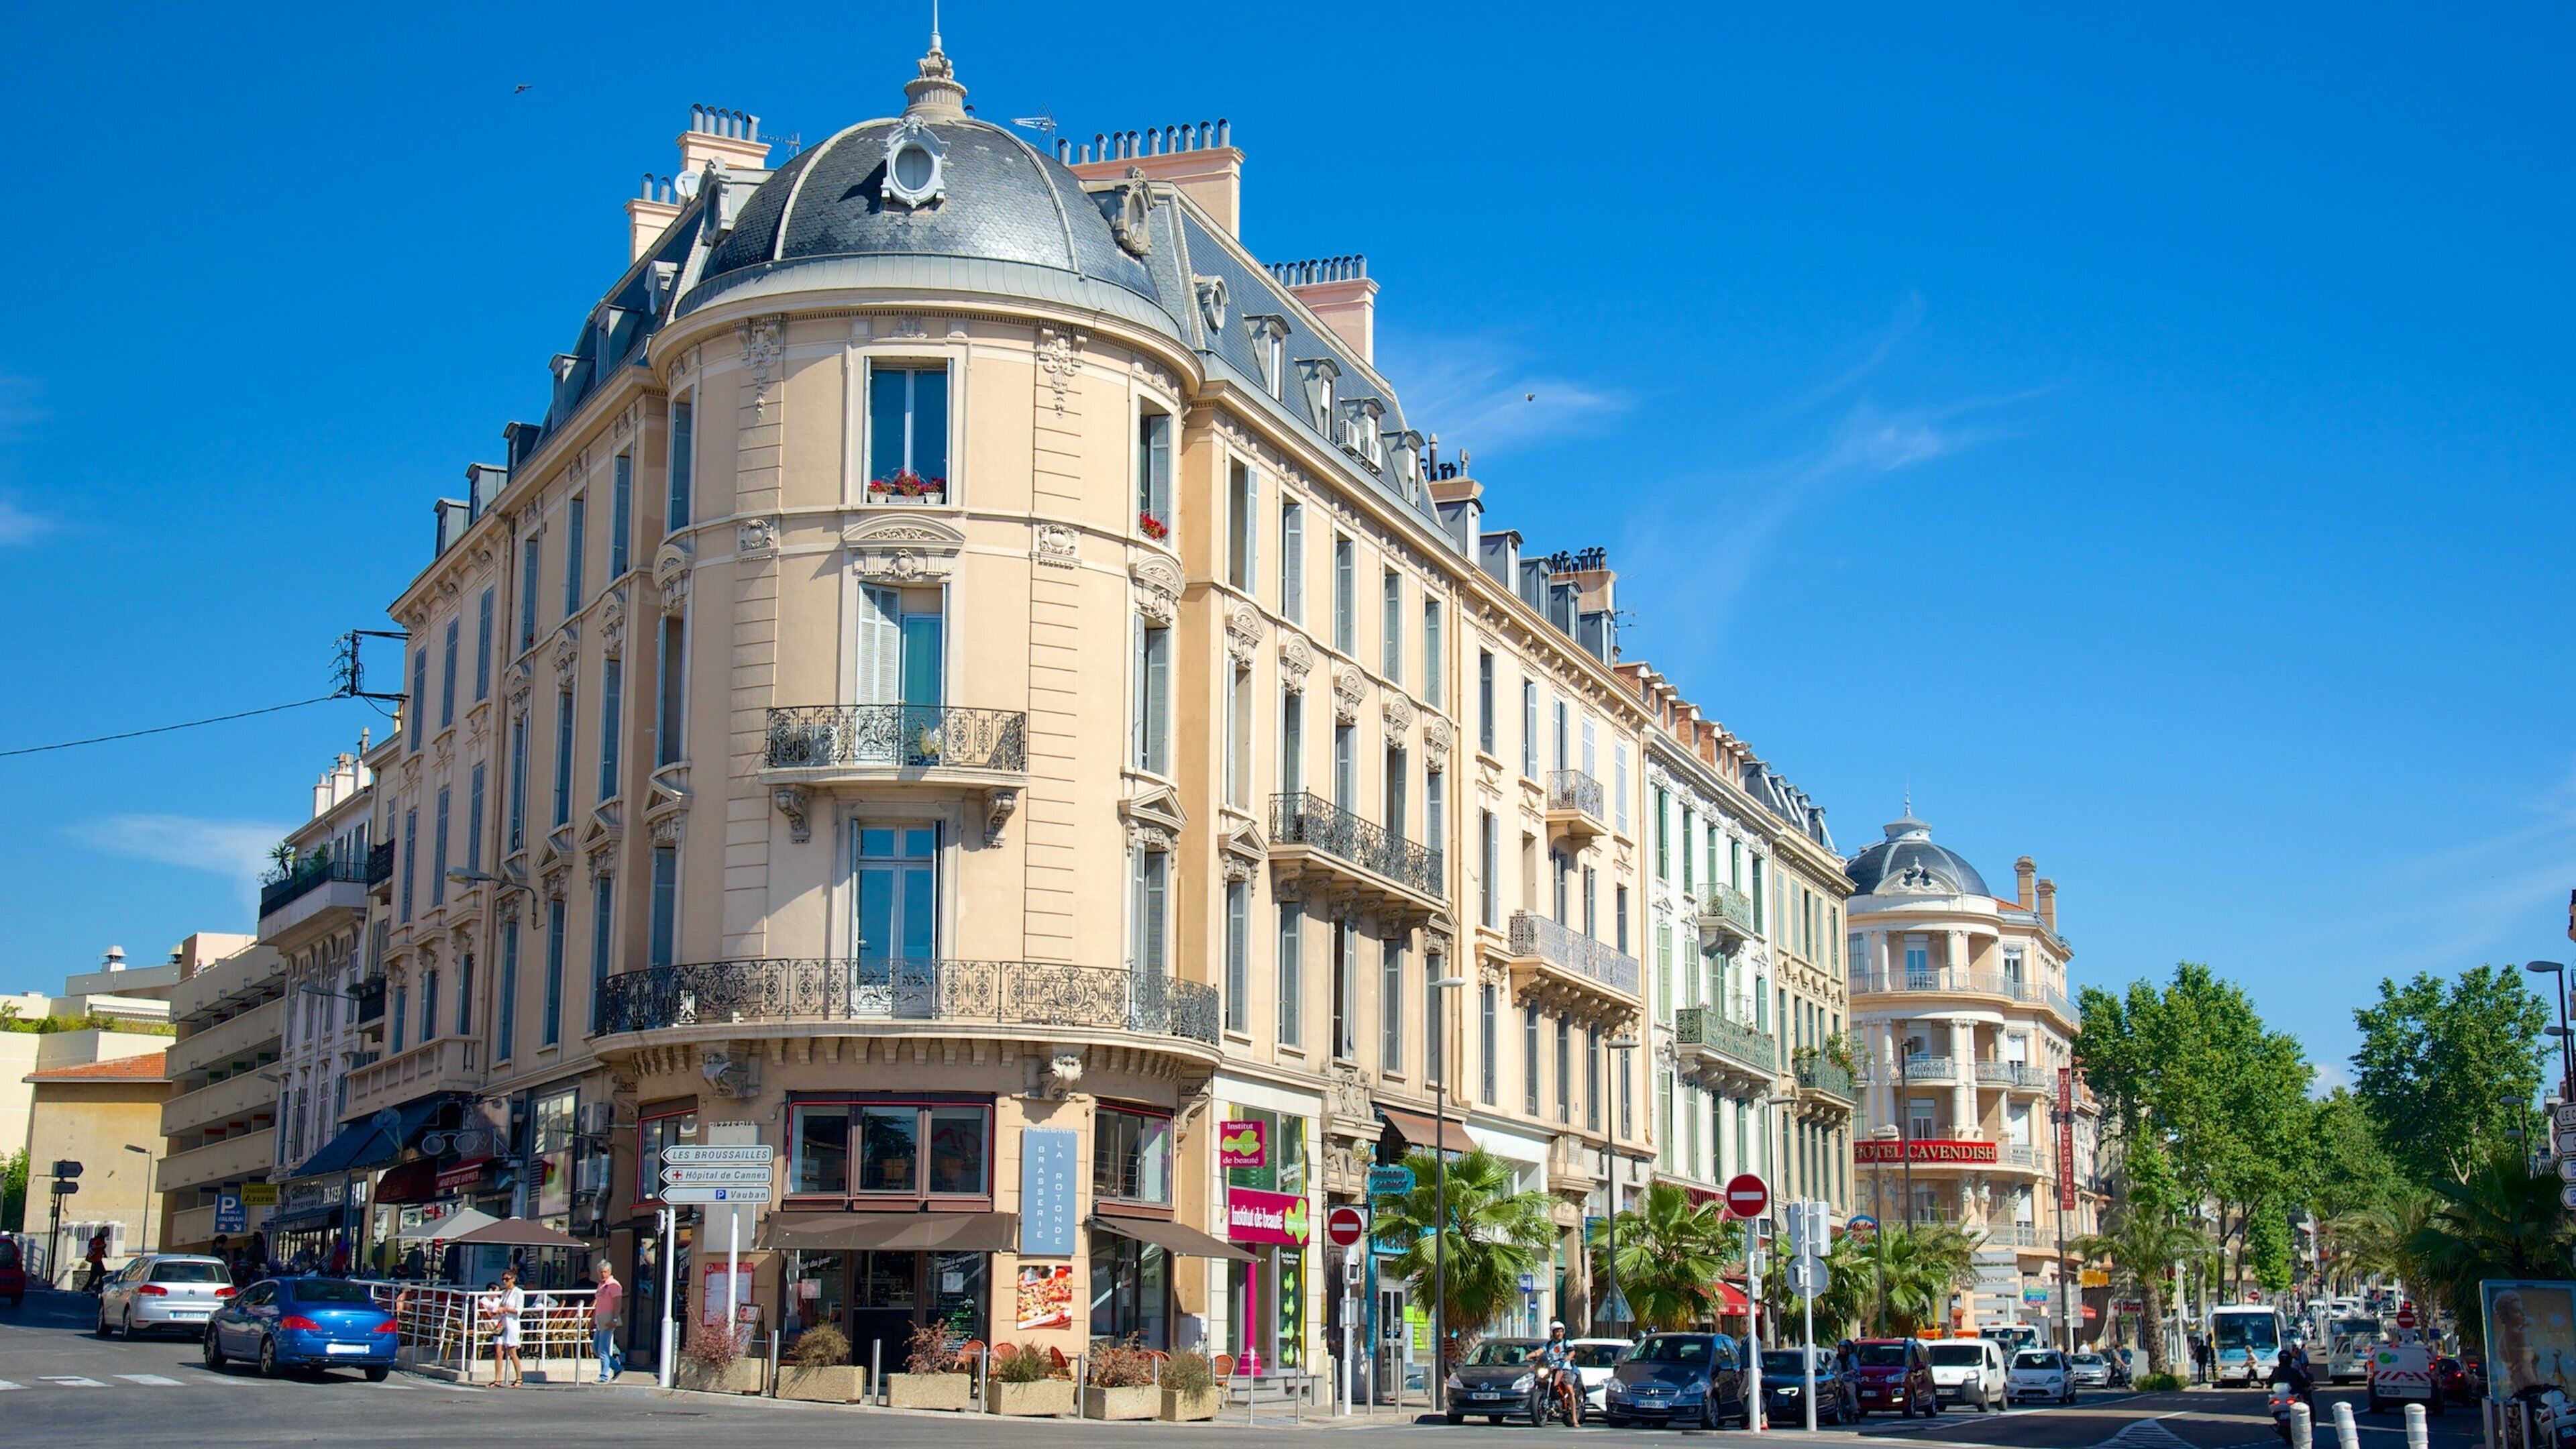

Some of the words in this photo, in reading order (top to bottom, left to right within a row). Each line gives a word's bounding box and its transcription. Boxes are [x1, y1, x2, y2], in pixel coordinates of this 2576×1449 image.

[2059, 1074, 2070, 1112] Hôtel
[2561, 1111, 2570, 1121] LE
[673, 1151, 690, 1159] LES
[694, 1150, 767, 1159] BROUSSAILLES
[1056, 1141, 1063, 1159] LA
[1856, 1144, 1903, 1159] HOTEL
[1908, 1144, 1996, 1161] CAVENDISH
[1234, 1156, 1259, 1164] beauté
[2061, 1124, 2072, 1200] Cavendish
[686, 1171, 717, 1181] Hôpital
[720, 1171, 731, 1179] de
[735, 1171, 767, 1179] Cannes
[717, 1191, 725, 1199] P
[731, 1190, 766, 1199] Vauban
[1037, 1146, 1045, 1238] BRASSERIE
[220, 1196, 237, 1214] P
[1055, 1173, 1063, 1244] ROTONDE
[1231, 1204, 1254, 1227] Institut
[1254, 1206, 1263, 1228] de
[1263, 1208, 1283, 1230] beauté
